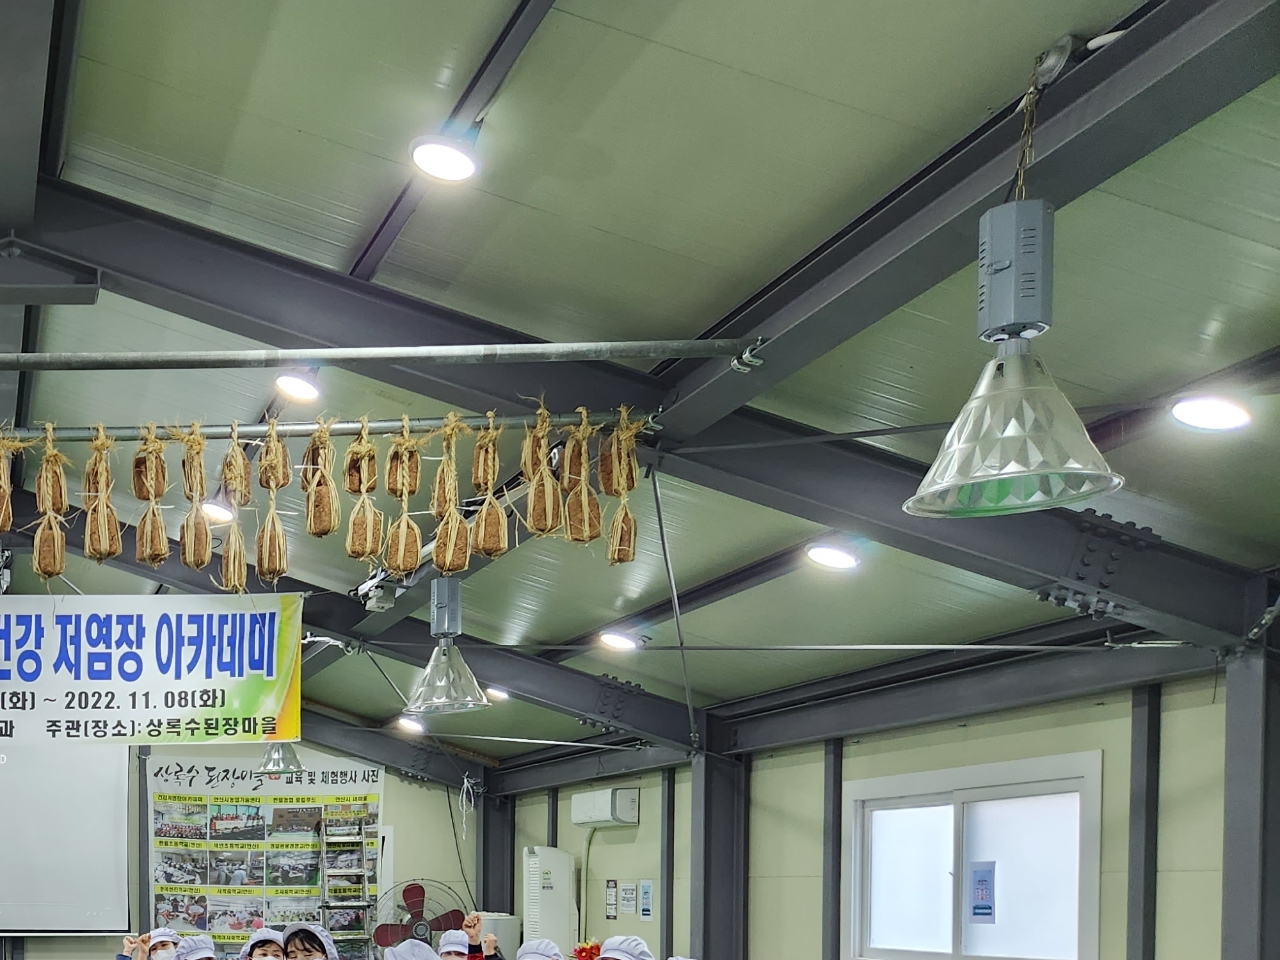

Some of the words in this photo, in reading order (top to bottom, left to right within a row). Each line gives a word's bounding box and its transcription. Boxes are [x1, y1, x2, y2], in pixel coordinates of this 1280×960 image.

[53, 613, 146, 682] 저염장
[155, 611, 276, 680] 아카데미
[64, 691, 121, 710] 2022.
[128, 691, 157, 710] 11.
[164, 688, 226, 709] 08(화)
[46, 718, 141, 738] 주관(장소):
[146, 716, 277, 738] 상록수된장마을
[153, 762, 202, 787] 상록수
[307, 771, 316, 785] 및
[321, 770, 357, 785] 체험행사
[361, 769, 379, 783] 사진
